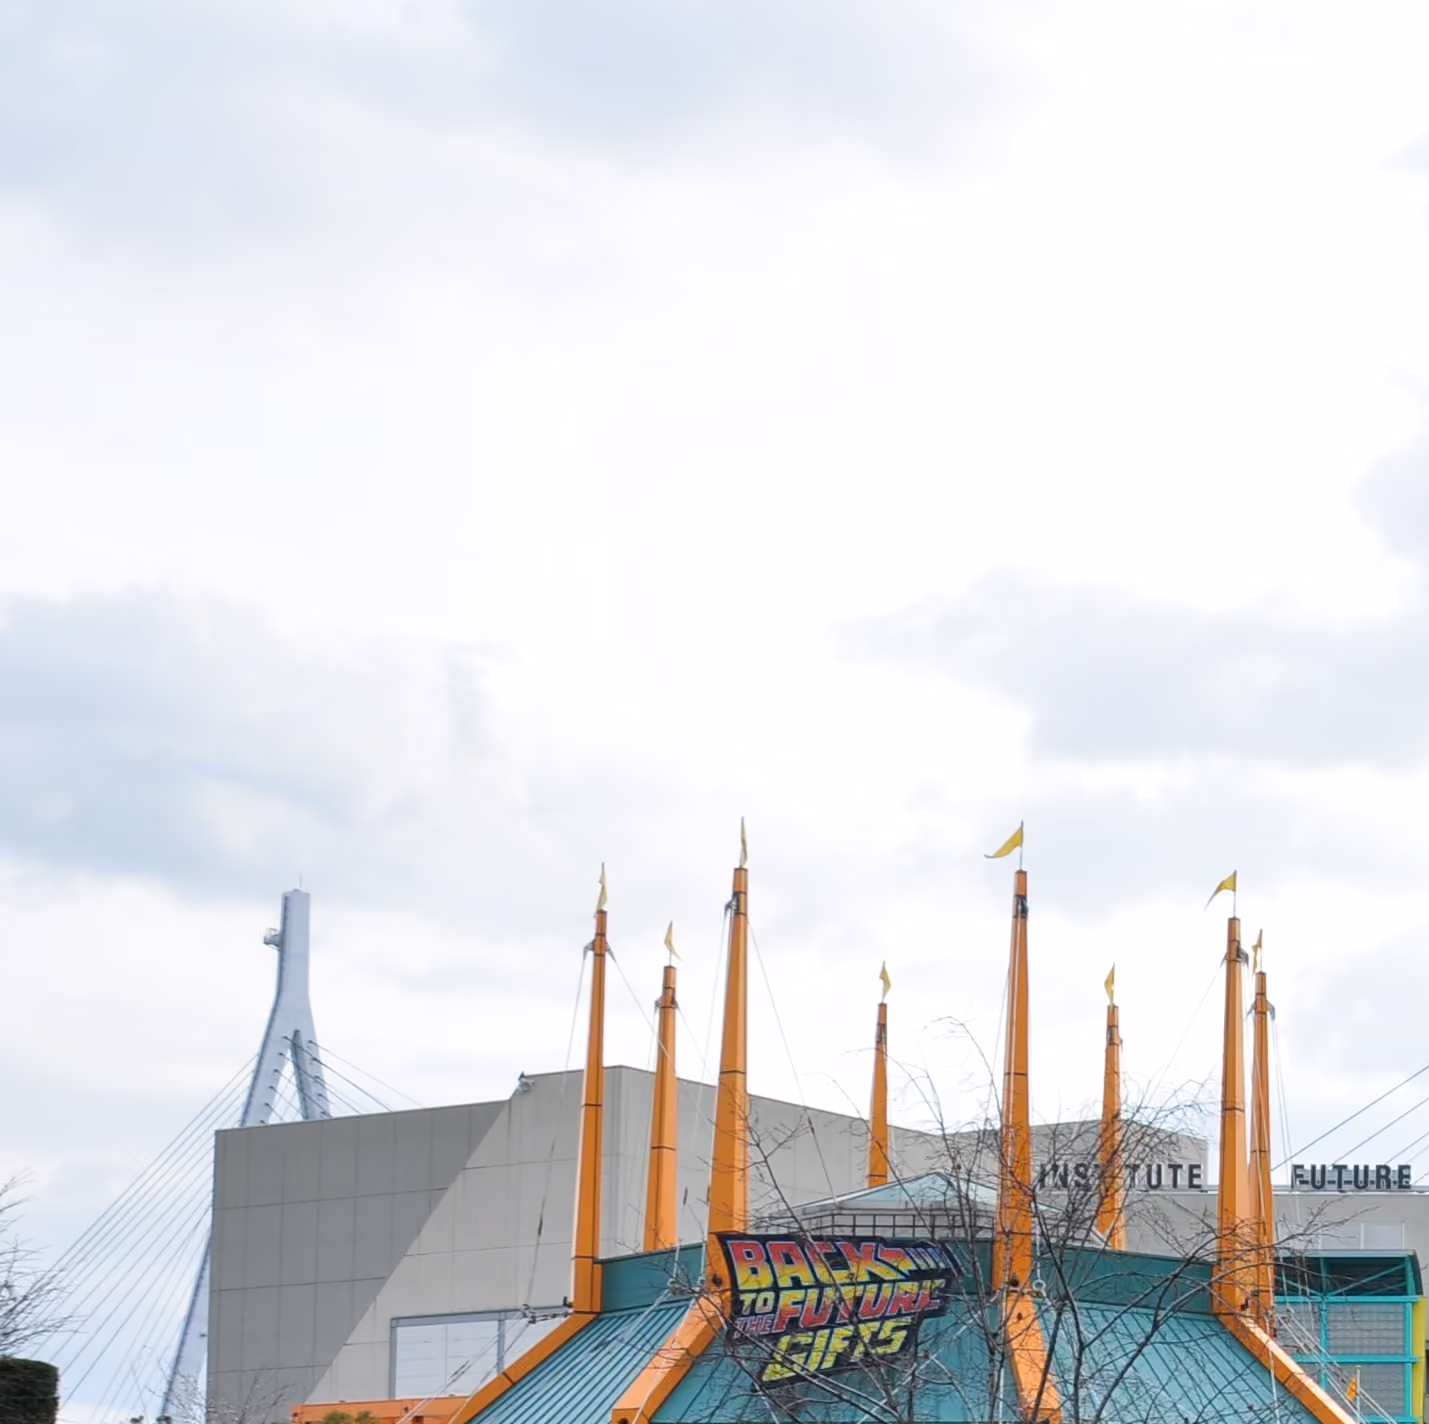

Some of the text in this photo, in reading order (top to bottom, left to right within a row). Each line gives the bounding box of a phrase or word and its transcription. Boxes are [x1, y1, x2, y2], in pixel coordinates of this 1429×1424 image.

[1039, 1162, 1205, 1192] INSTUTE
[1291, 1162, 1412, 1192] FUTURE
[727, 1239, 948, 1290] BACK
[739, 1290, 774, 1315] TO
[772, 1279, 948, 1334] FUTURE
[762, 1316, 912, 1383] GIFTS
